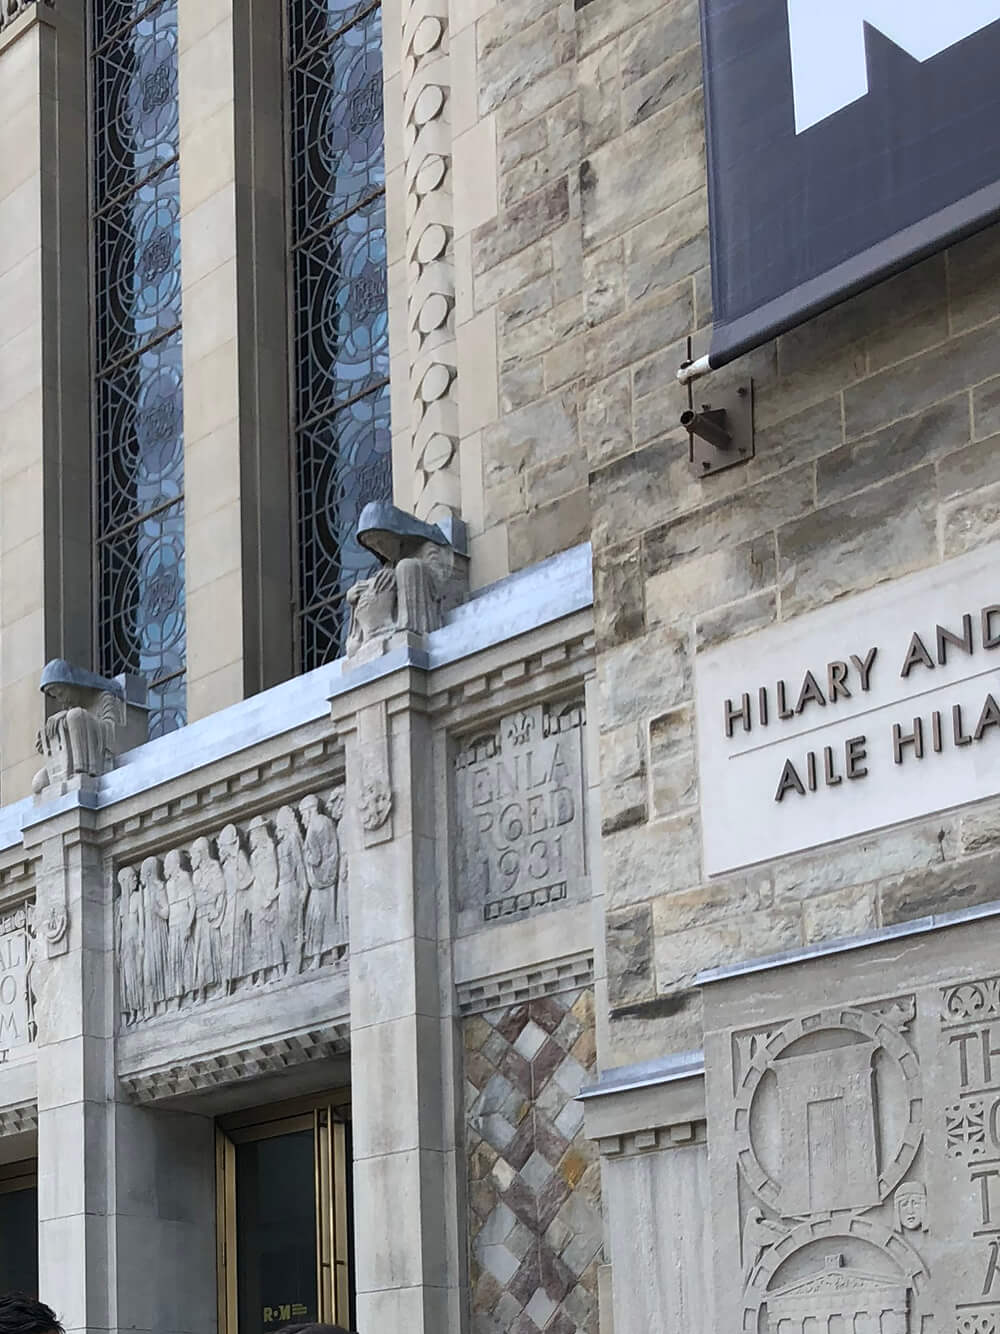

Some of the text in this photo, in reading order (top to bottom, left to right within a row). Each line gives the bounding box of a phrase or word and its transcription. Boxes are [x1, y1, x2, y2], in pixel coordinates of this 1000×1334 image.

[724, 604, 1000, 738] HILARY AND
[774, 692, 1000, 803] AILE HILA
[483, 834, 563, 896] 1931
[949, 1029, 1000, 1088] TH
